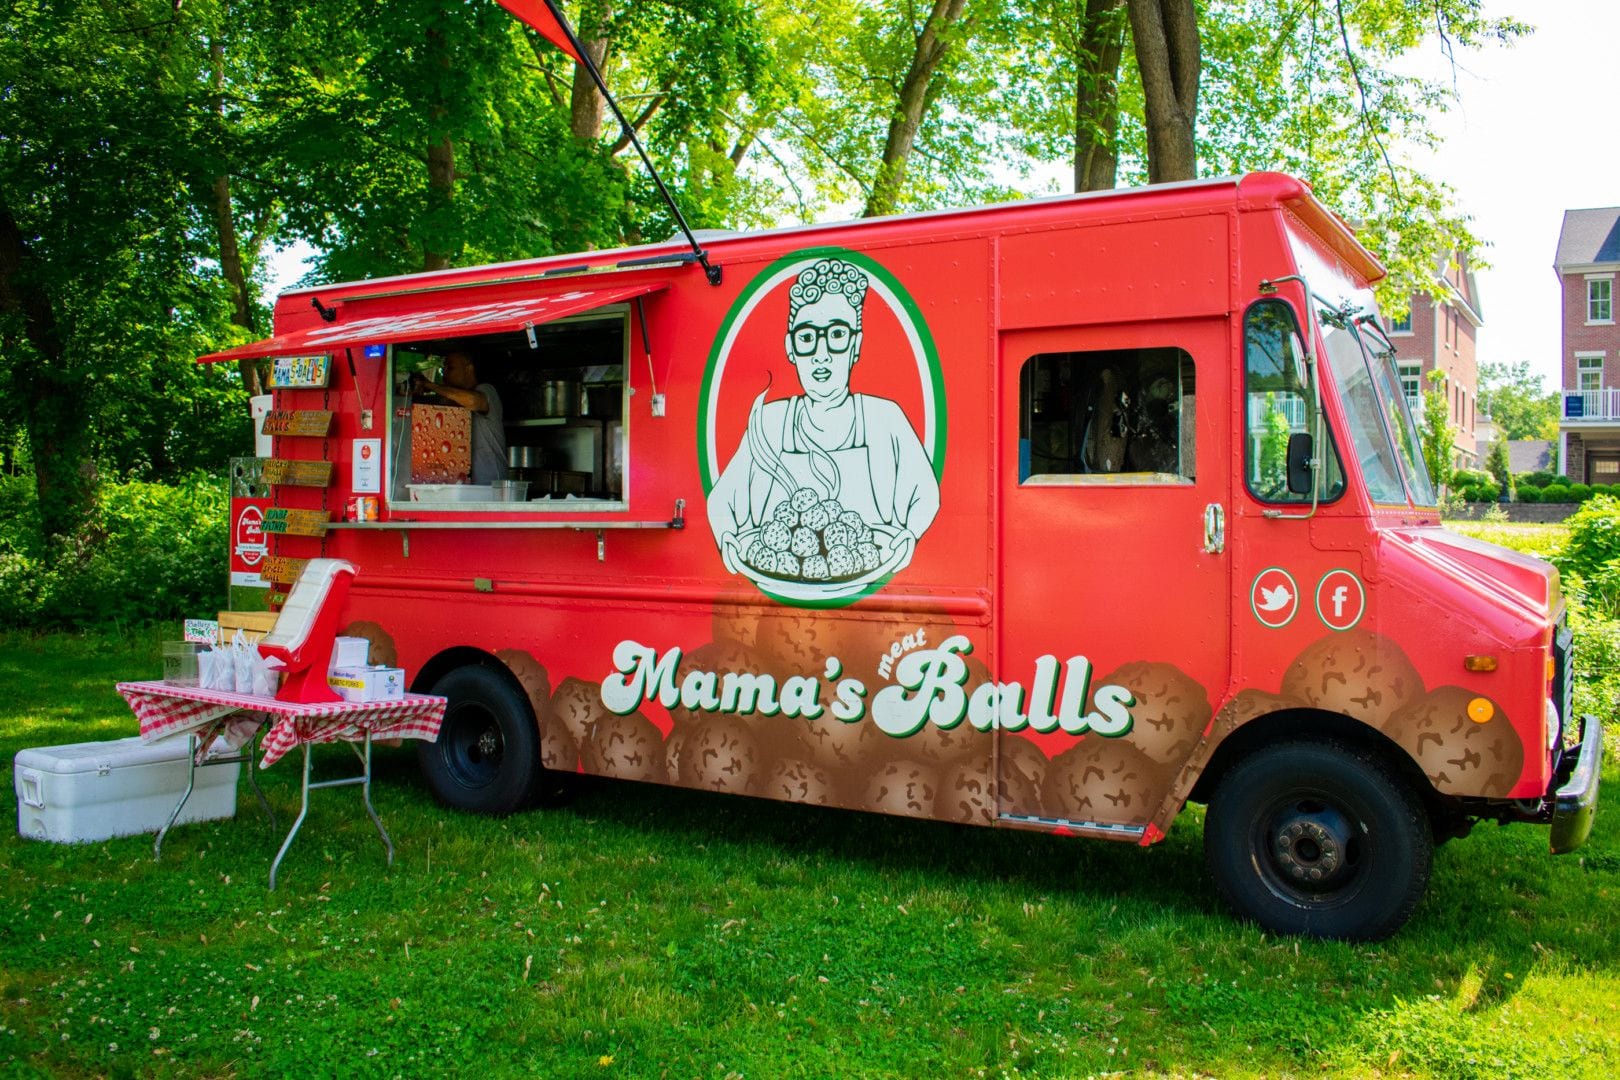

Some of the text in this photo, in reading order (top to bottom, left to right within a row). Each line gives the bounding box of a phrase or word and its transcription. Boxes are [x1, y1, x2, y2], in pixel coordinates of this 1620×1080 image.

[600, 627, 1136, 738] Mama's meat Balls
